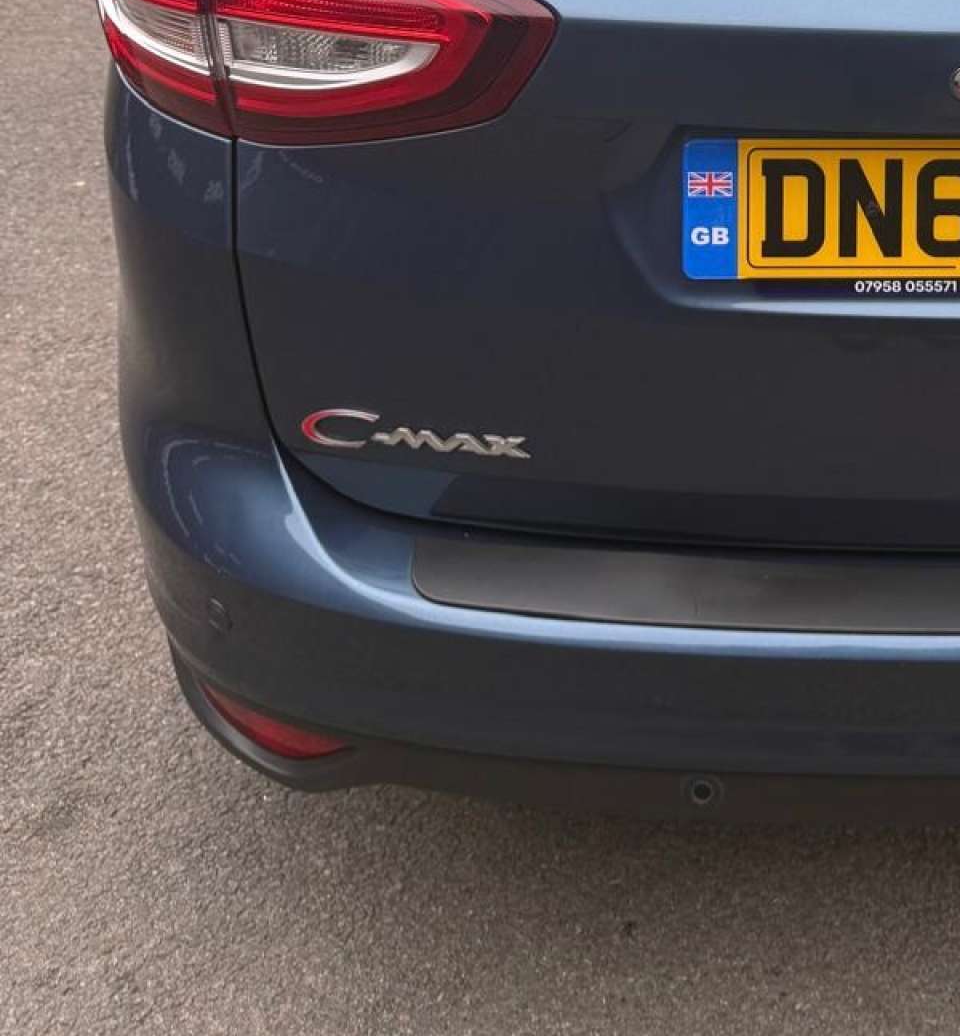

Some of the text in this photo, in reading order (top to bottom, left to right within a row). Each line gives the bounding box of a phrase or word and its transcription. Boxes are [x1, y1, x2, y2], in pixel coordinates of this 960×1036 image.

[691, 226, 730, 245] GB
[854, 280, 957, 293] 07958 055571
[301, 408, 531, 459] C-MAX
